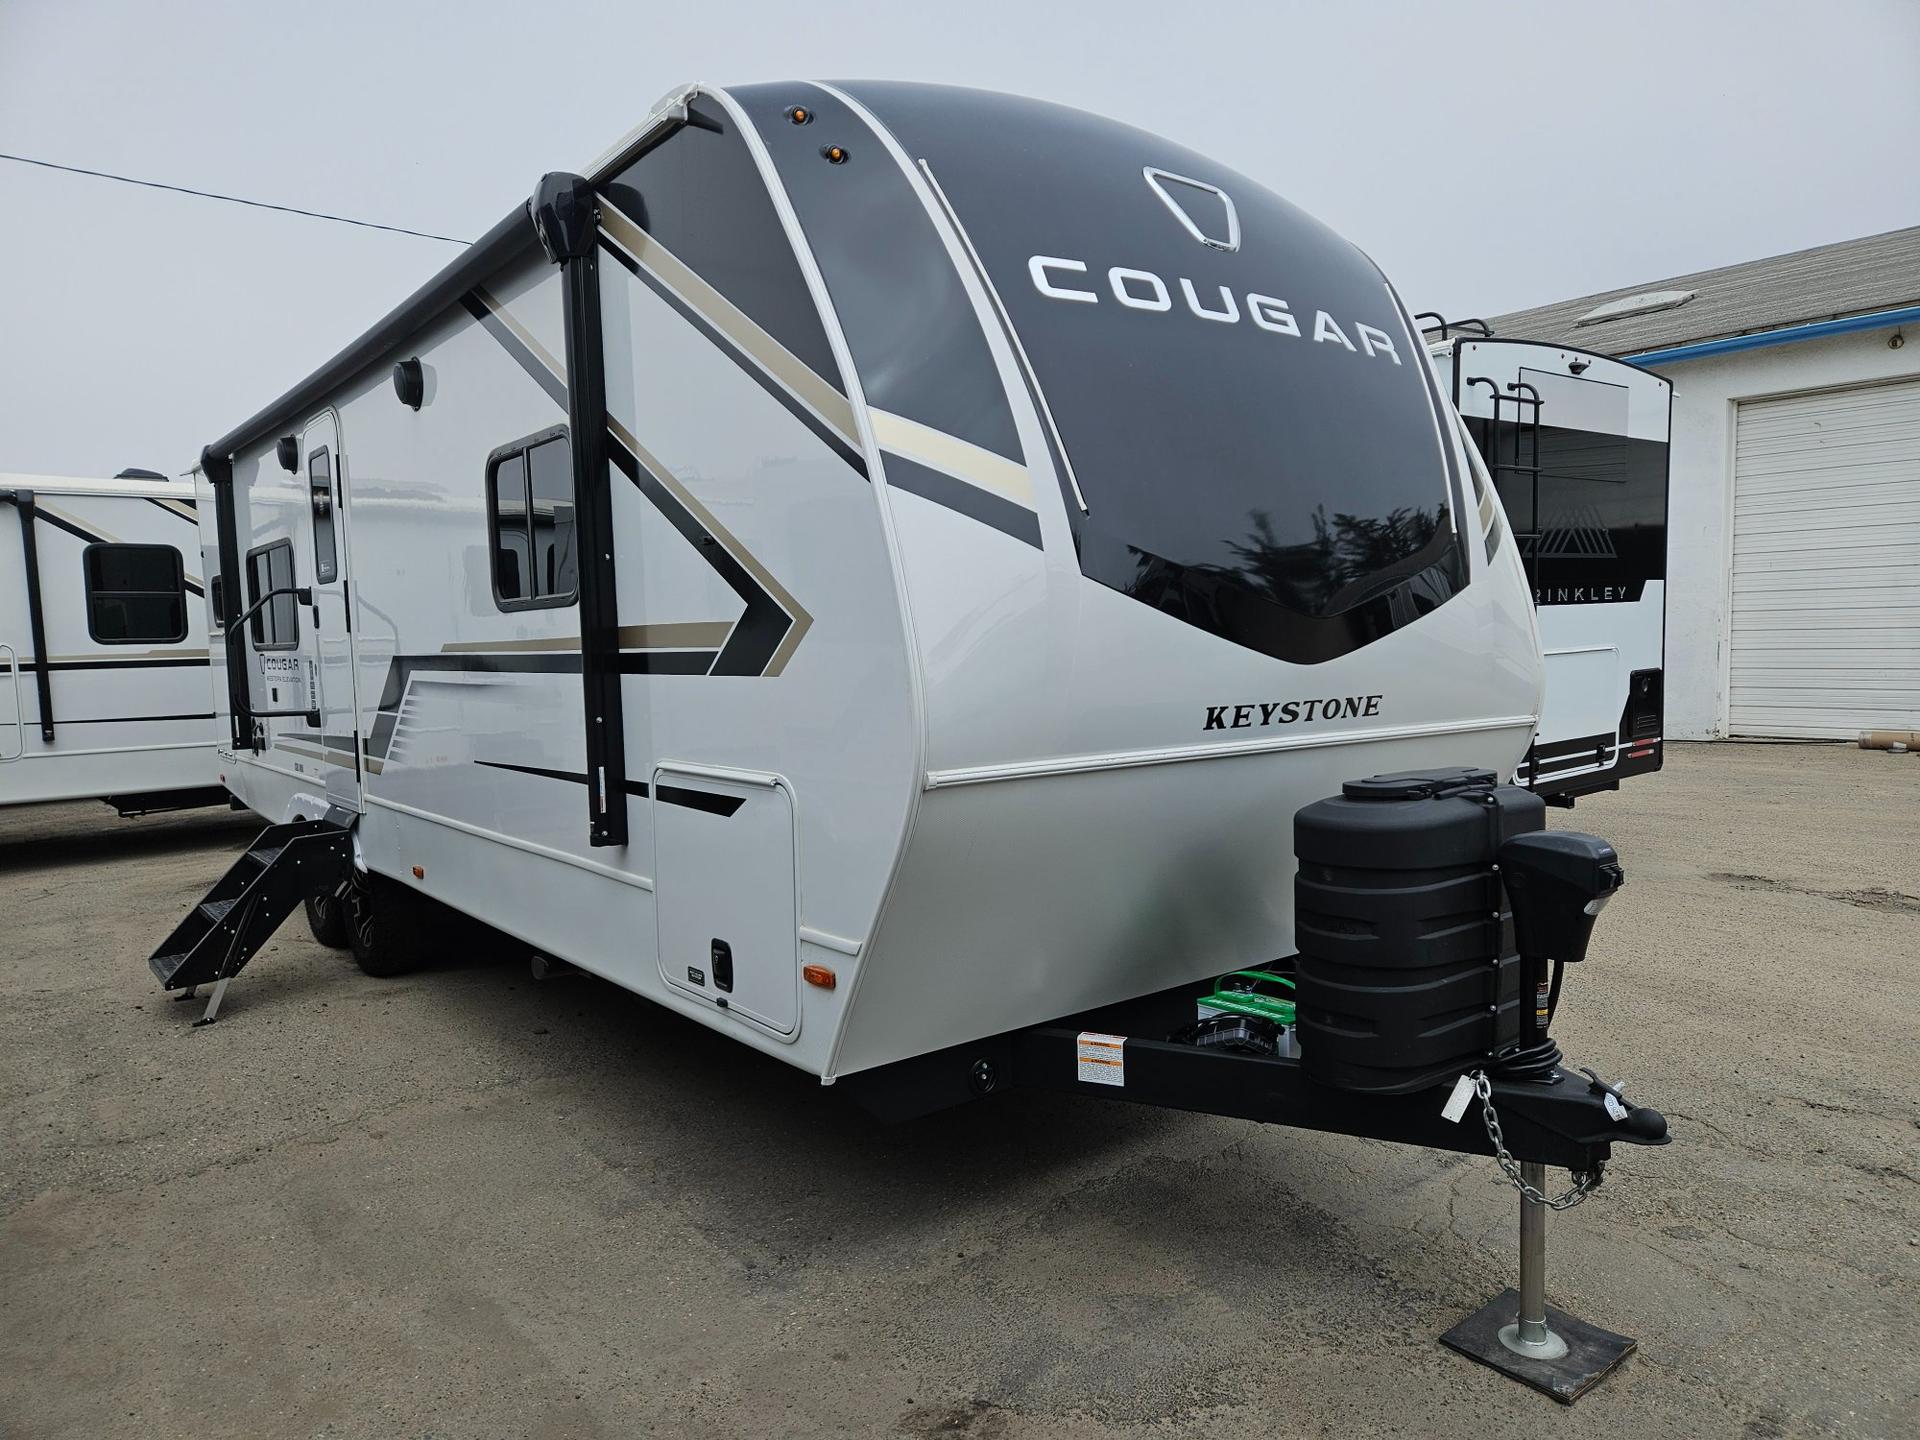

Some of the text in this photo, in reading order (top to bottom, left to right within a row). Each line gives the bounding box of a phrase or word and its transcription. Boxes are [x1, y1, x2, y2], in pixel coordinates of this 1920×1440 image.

[1028, 255, 1401, 365] COUGAR
[266, 658, 299, 671] COUGAR
[1203, 695, 1383, 730] KEYSTONE
